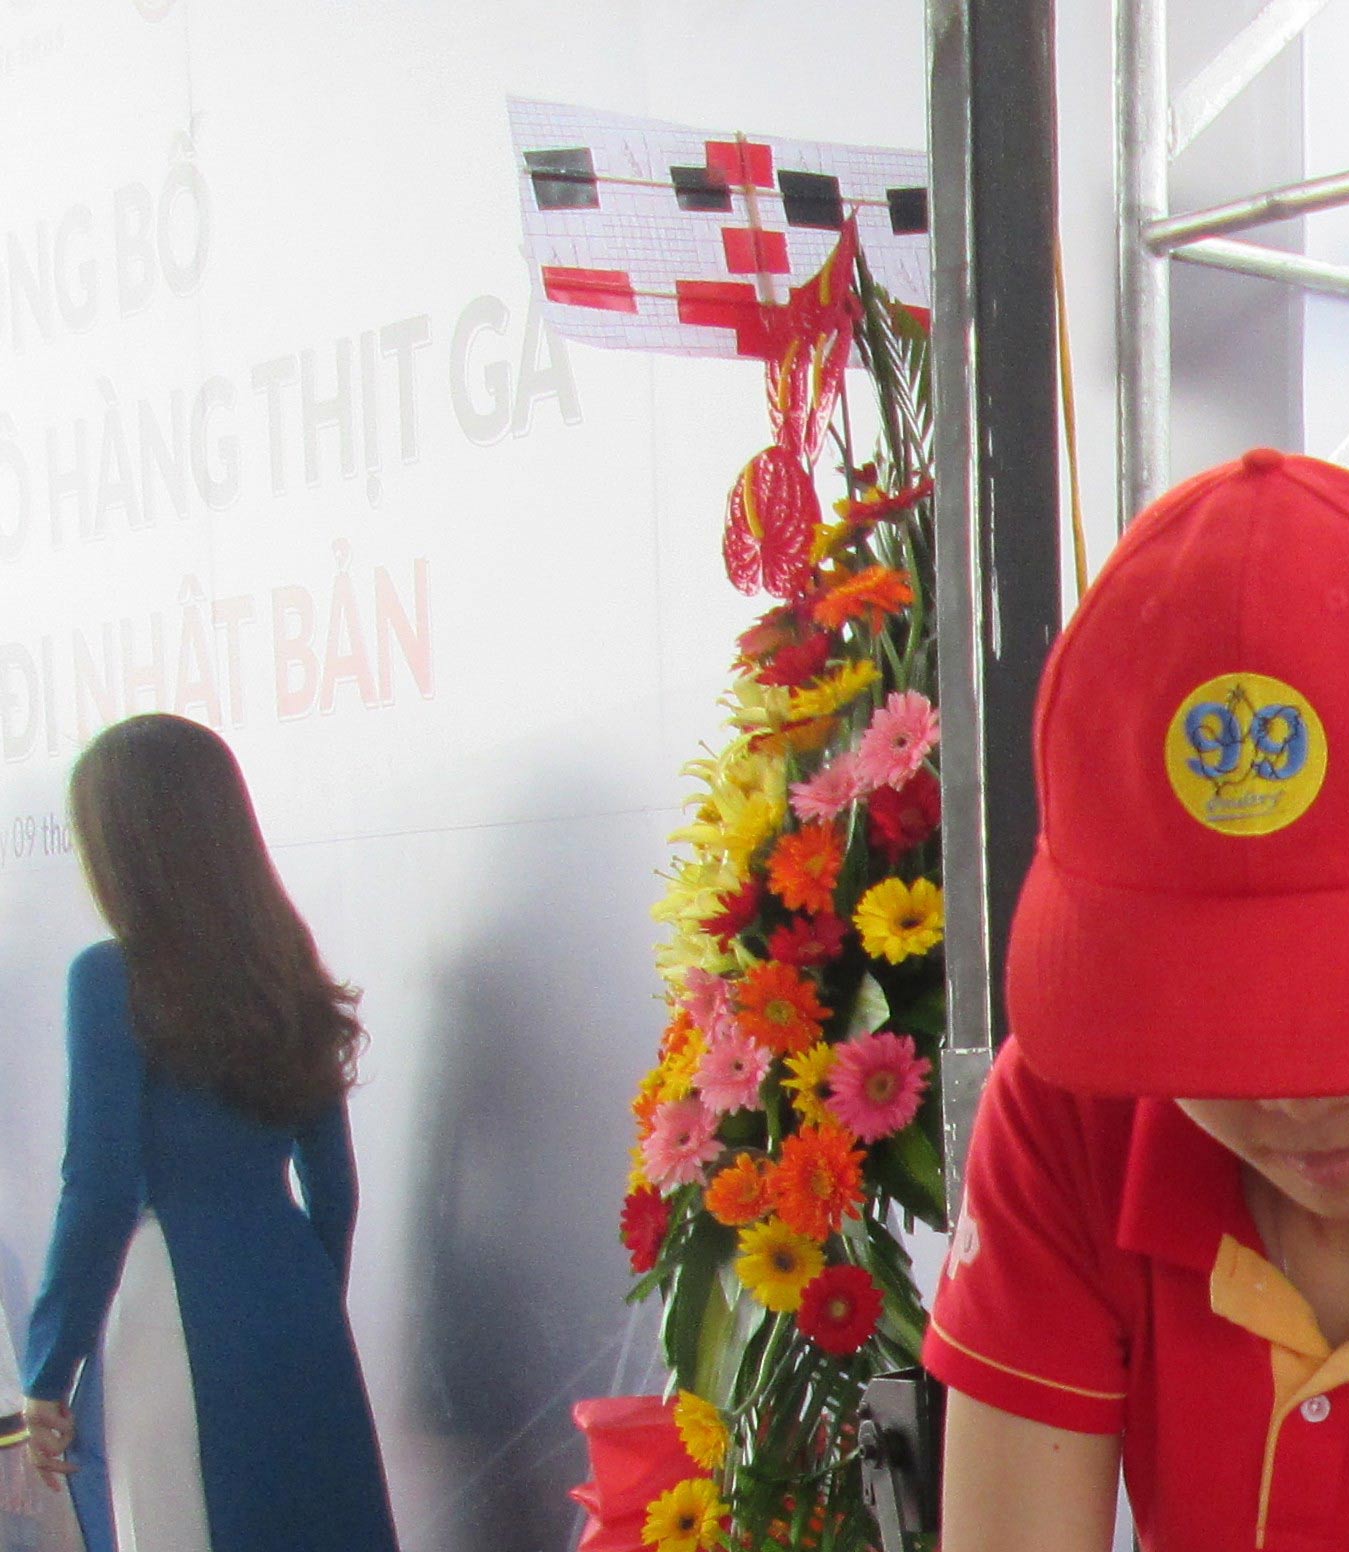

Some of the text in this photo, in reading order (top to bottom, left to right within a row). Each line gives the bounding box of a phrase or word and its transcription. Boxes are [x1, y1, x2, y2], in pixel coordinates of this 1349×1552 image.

[45, 376, 240, 549] HÀNG
[252, 313, 431, 508] THỊT
[271, 537, 438, 723] BẢN
[1184, 701, 1311, 781] 99
